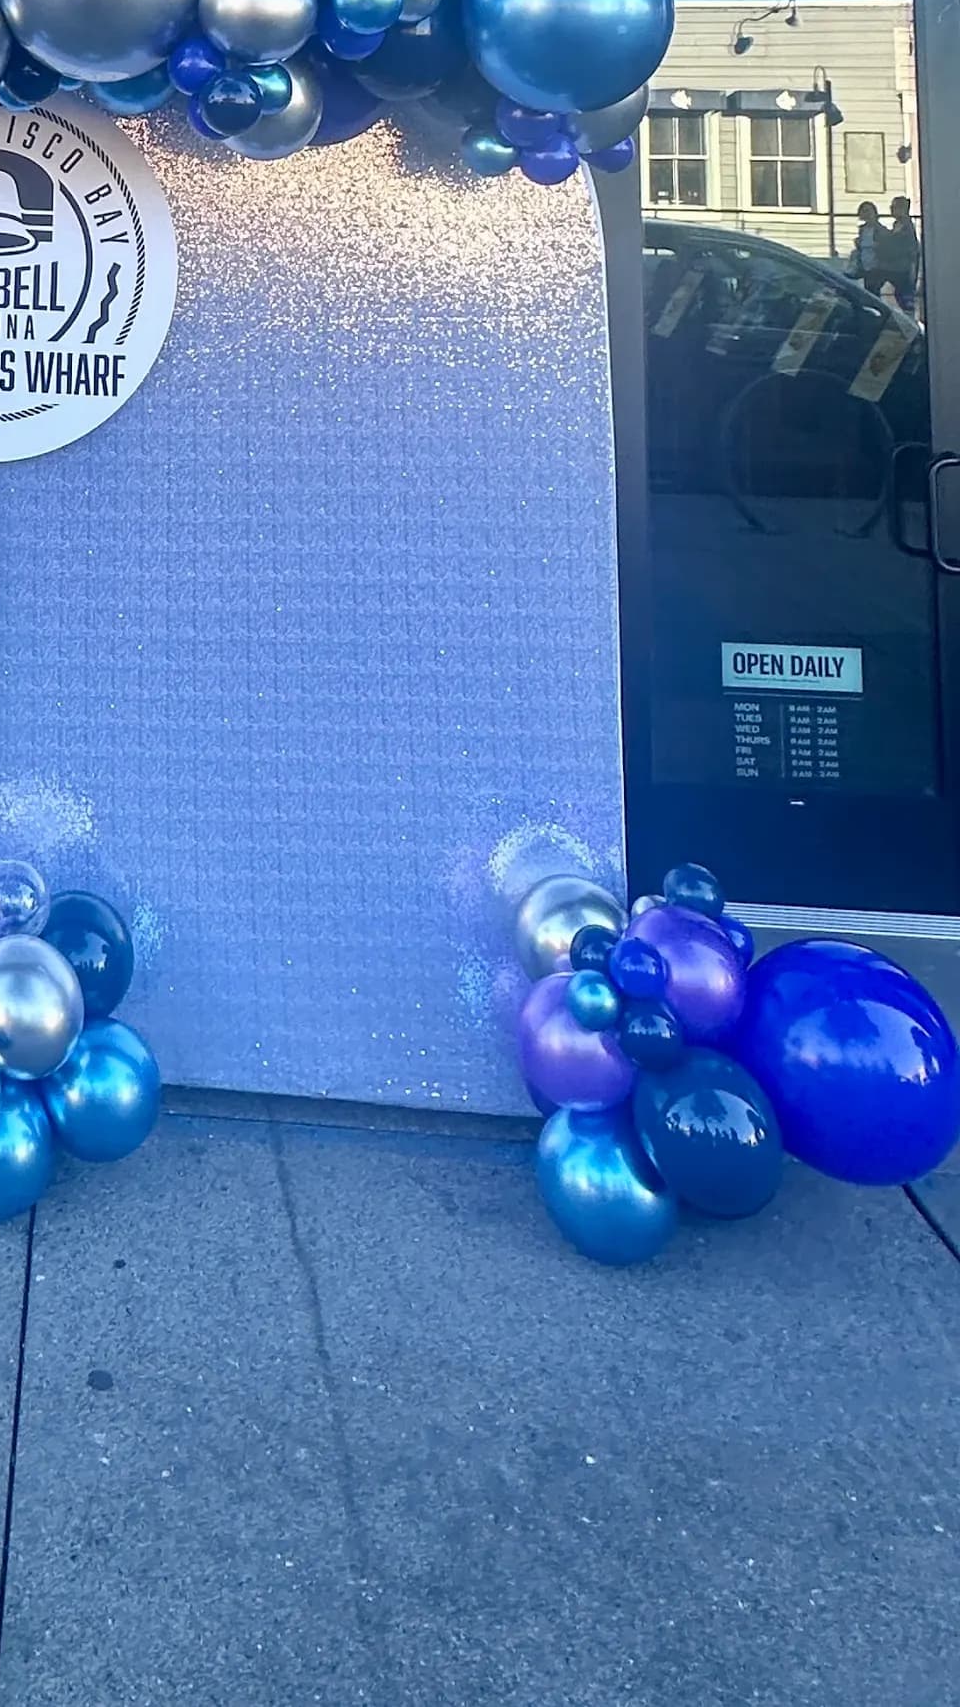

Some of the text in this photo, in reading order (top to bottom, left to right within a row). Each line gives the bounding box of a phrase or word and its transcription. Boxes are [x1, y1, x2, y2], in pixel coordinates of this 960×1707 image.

[84, 183, 130, 246] BAY
[25, 350, 127, 398] WHARF
[732, 651, 845, 679] OPEN DAILY
